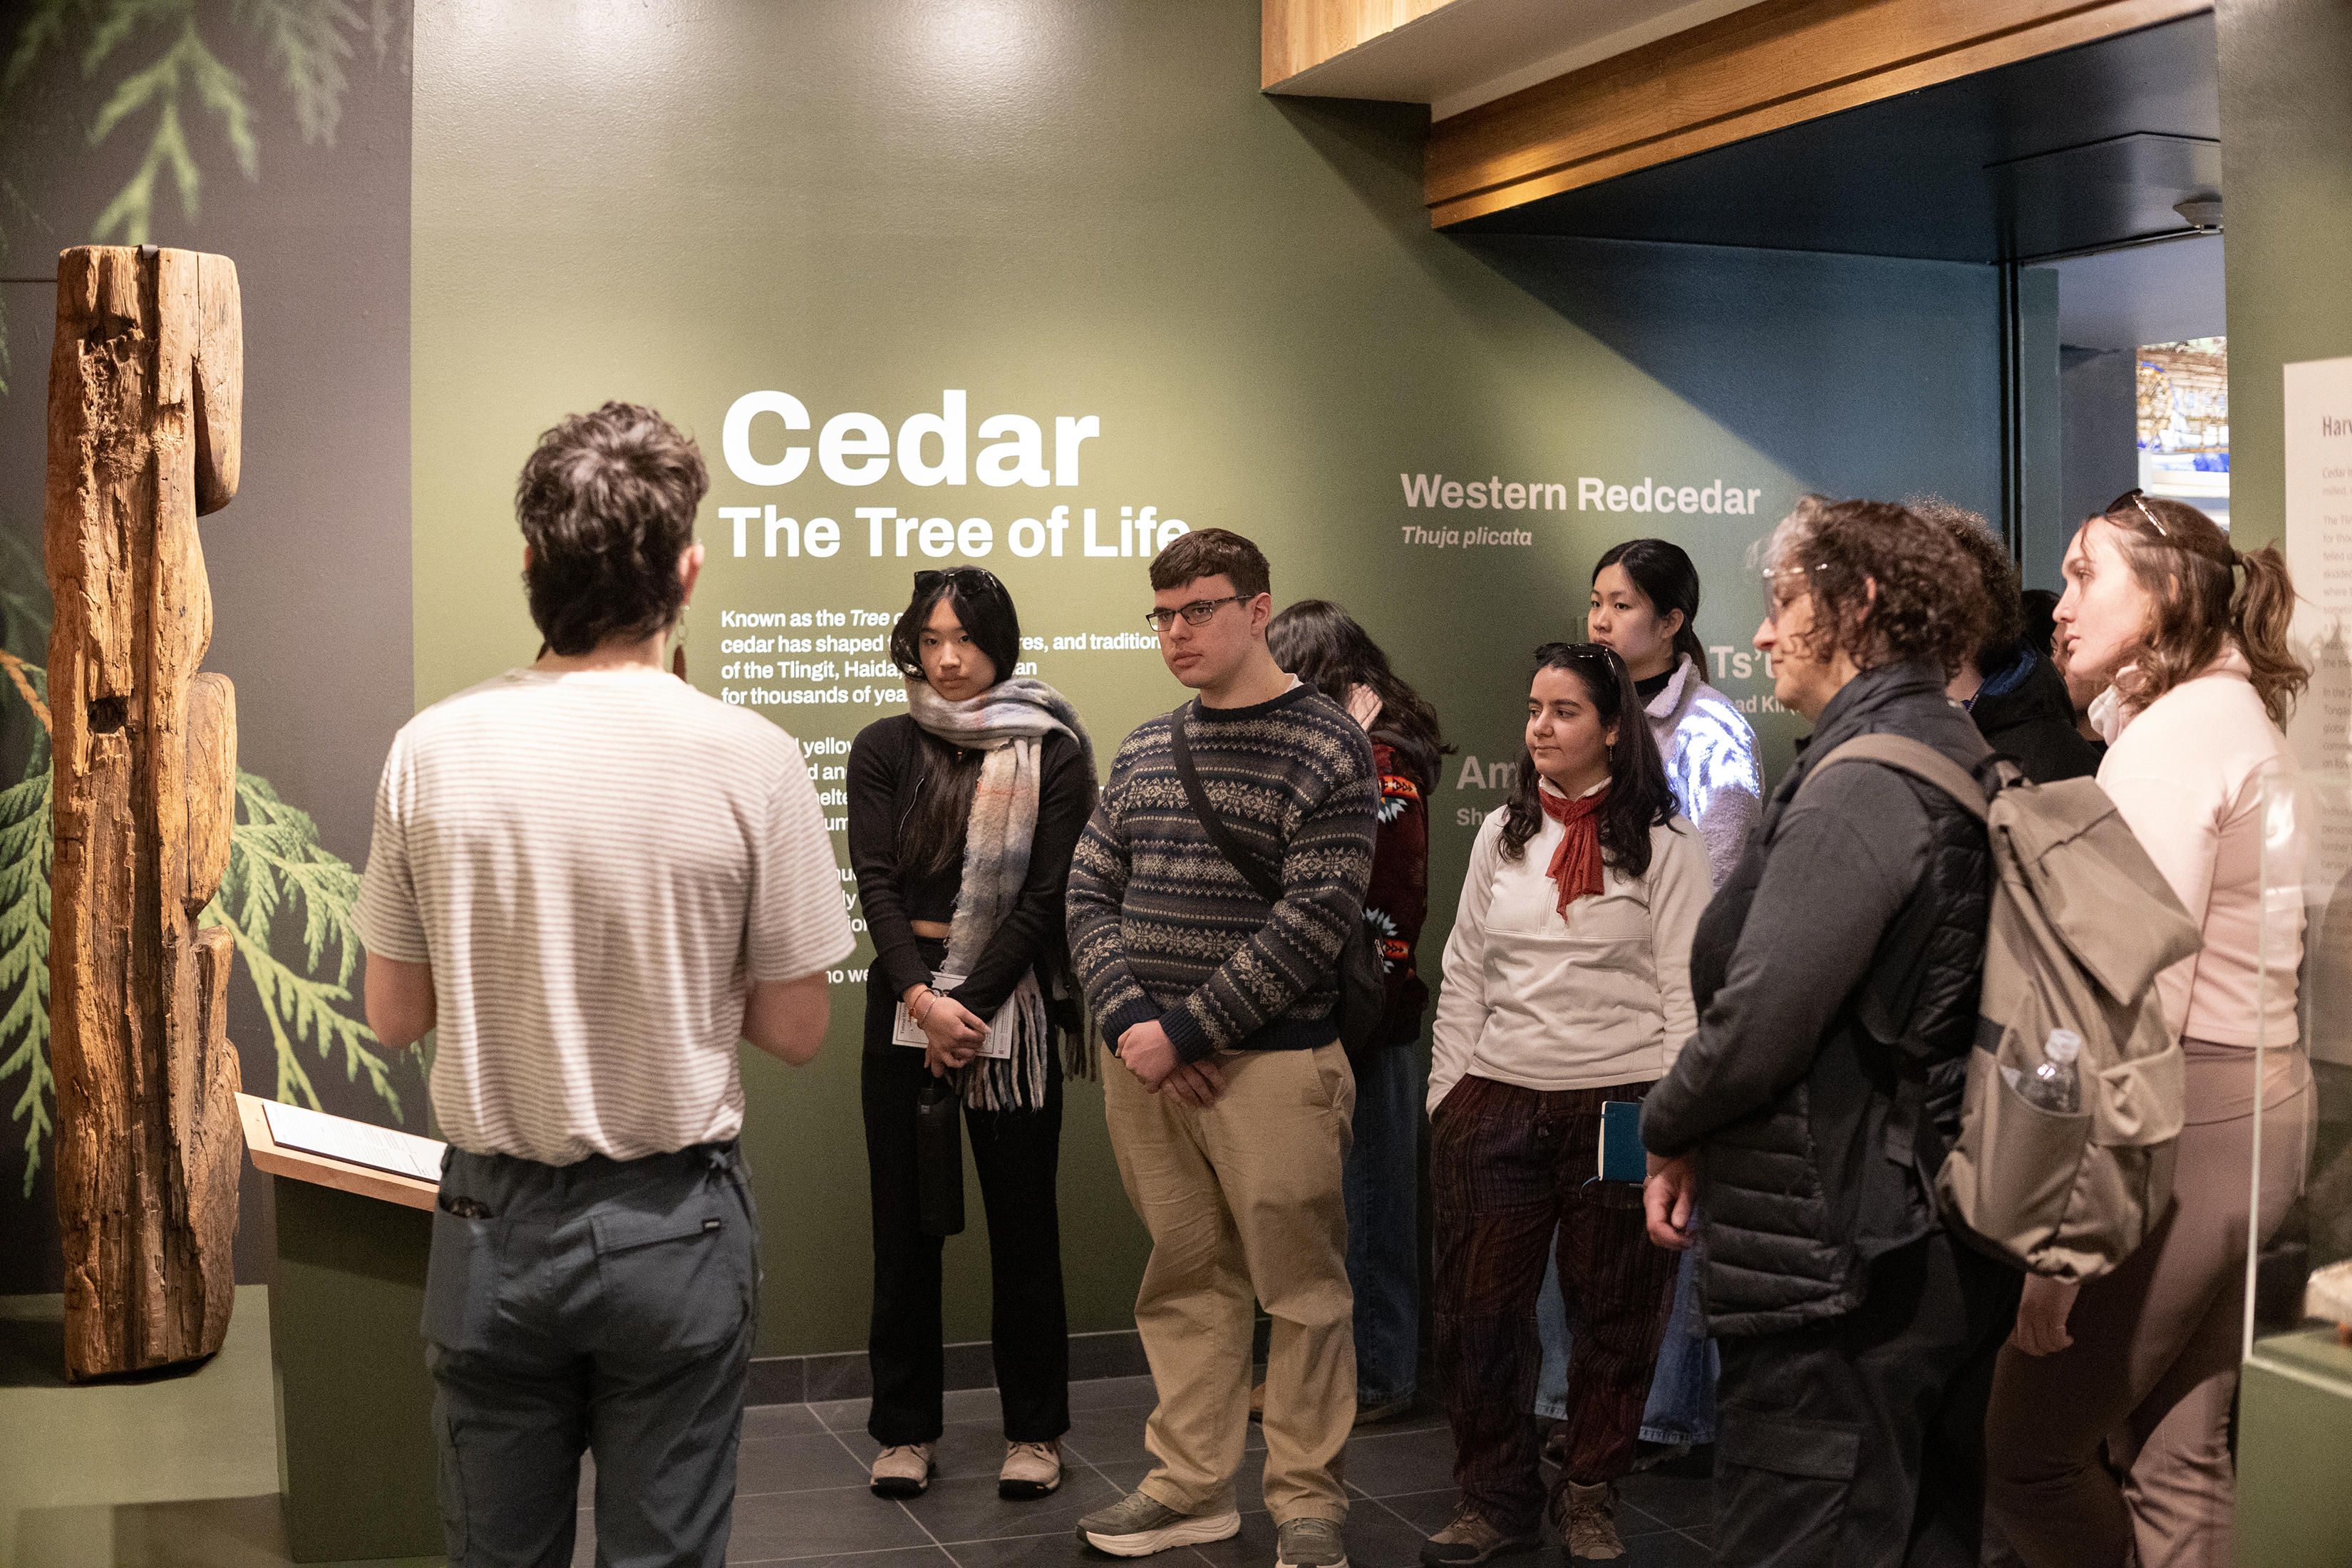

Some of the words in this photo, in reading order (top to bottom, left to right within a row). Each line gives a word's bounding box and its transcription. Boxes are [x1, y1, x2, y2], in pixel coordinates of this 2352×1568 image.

[722, 389, 1100, 488] Cedar
[1401, 473, 1567, 511] Western
[1577, 477, 1761, 515] Redcedar
[718, 505, 840, 558] The
[855, 507, 994, 558] Tree
[1008, 505, 1069, 558] of
[1083, 505, 1190, 557] Life
[1402, 526, 1459, 548] Thuja
[1463, 527, 1532, 548] plicata
[721, 611, 785, 627] Known
[790, 614, 812, 627] as
[816, 609, 846, 627] the
[850, 610, 890, 626] Tree
[721, 636, 775, 654] cedar
[778, 635, 812, 653] has
[816, 634, 884, 655] shaped
[1053, 633, 1086, 650] and
[721, 661, 741, 679] of
[743, 661, 773, 679] the
[778, 661, 840, 681] Tlingit,
[845, 659, 903, 679] Haida,
[721, 686, 747, 705] for
[751, 686, 849, 705] thousands
[852, 686, 872, 703] of
